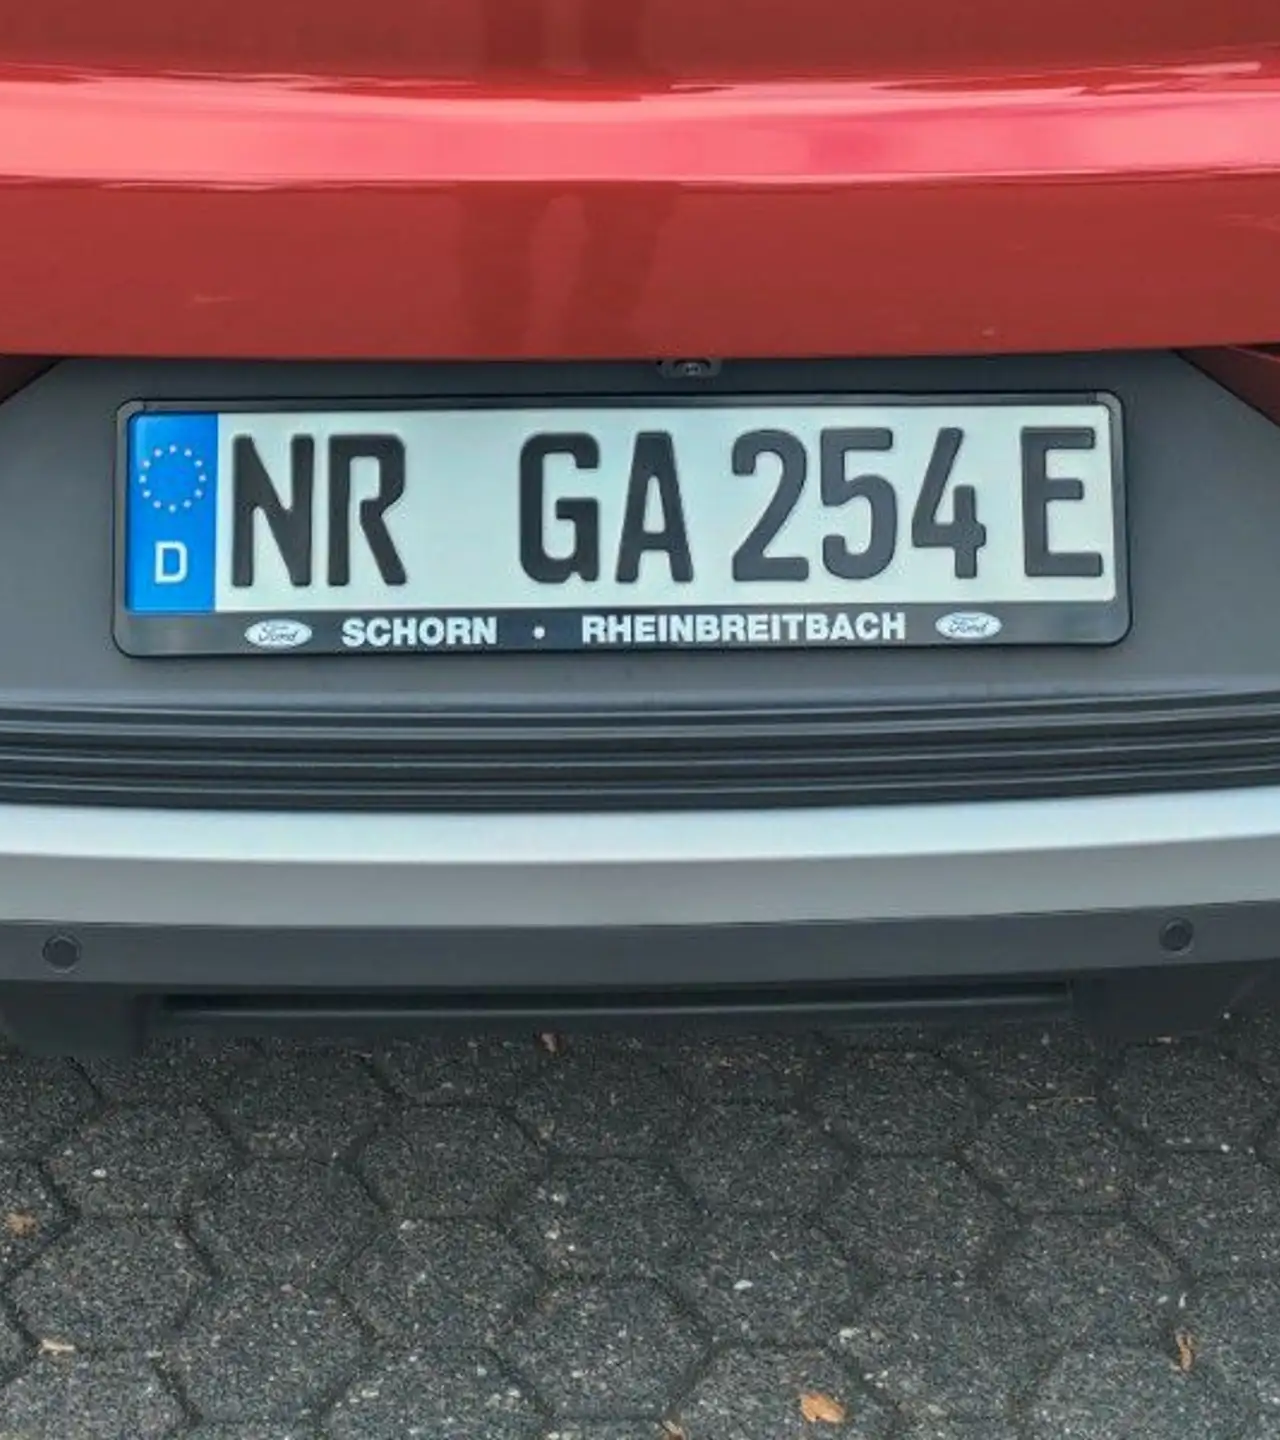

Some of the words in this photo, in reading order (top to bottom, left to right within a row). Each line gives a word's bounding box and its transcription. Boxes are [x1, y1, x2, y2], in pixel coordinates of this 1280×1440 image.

[154, 541, 188, 584] D
[231, 433, 408, 588] NR
[520, 431, 694, 584] GA
[341, 616, 498, 647] SCHORN
[581, 611, 906, 643] RHEINBREITBACH
